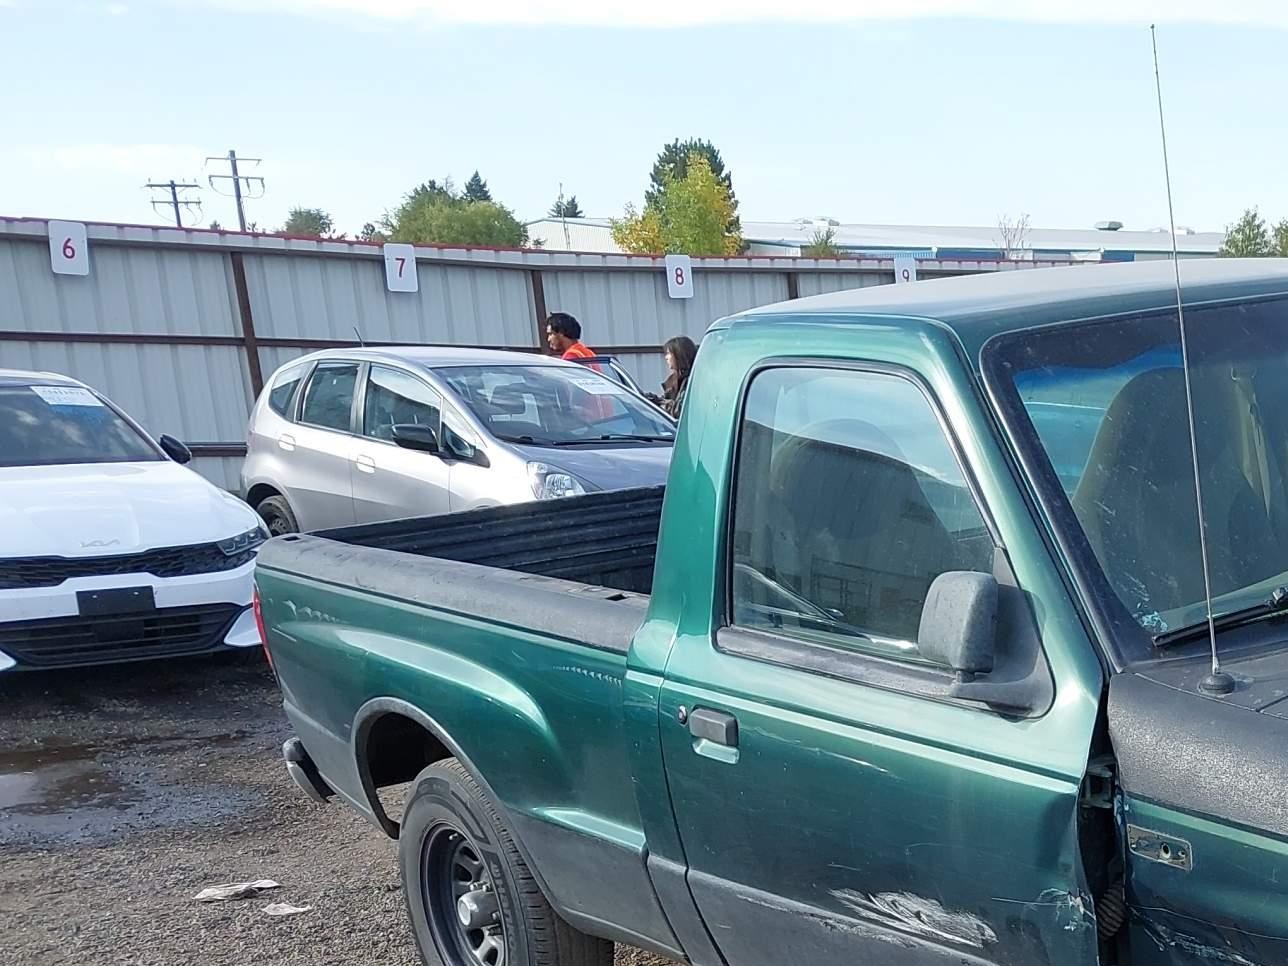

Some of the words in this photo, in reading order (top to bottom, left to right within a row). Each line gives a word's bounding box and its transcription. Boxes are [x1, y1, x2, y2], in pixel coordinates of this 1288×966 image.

[62, 237, 76, 259] 6
[395, 257, 407, 278] 7
[674, 266, 685, 286] 8
[902, 268, 910, 283] 9
